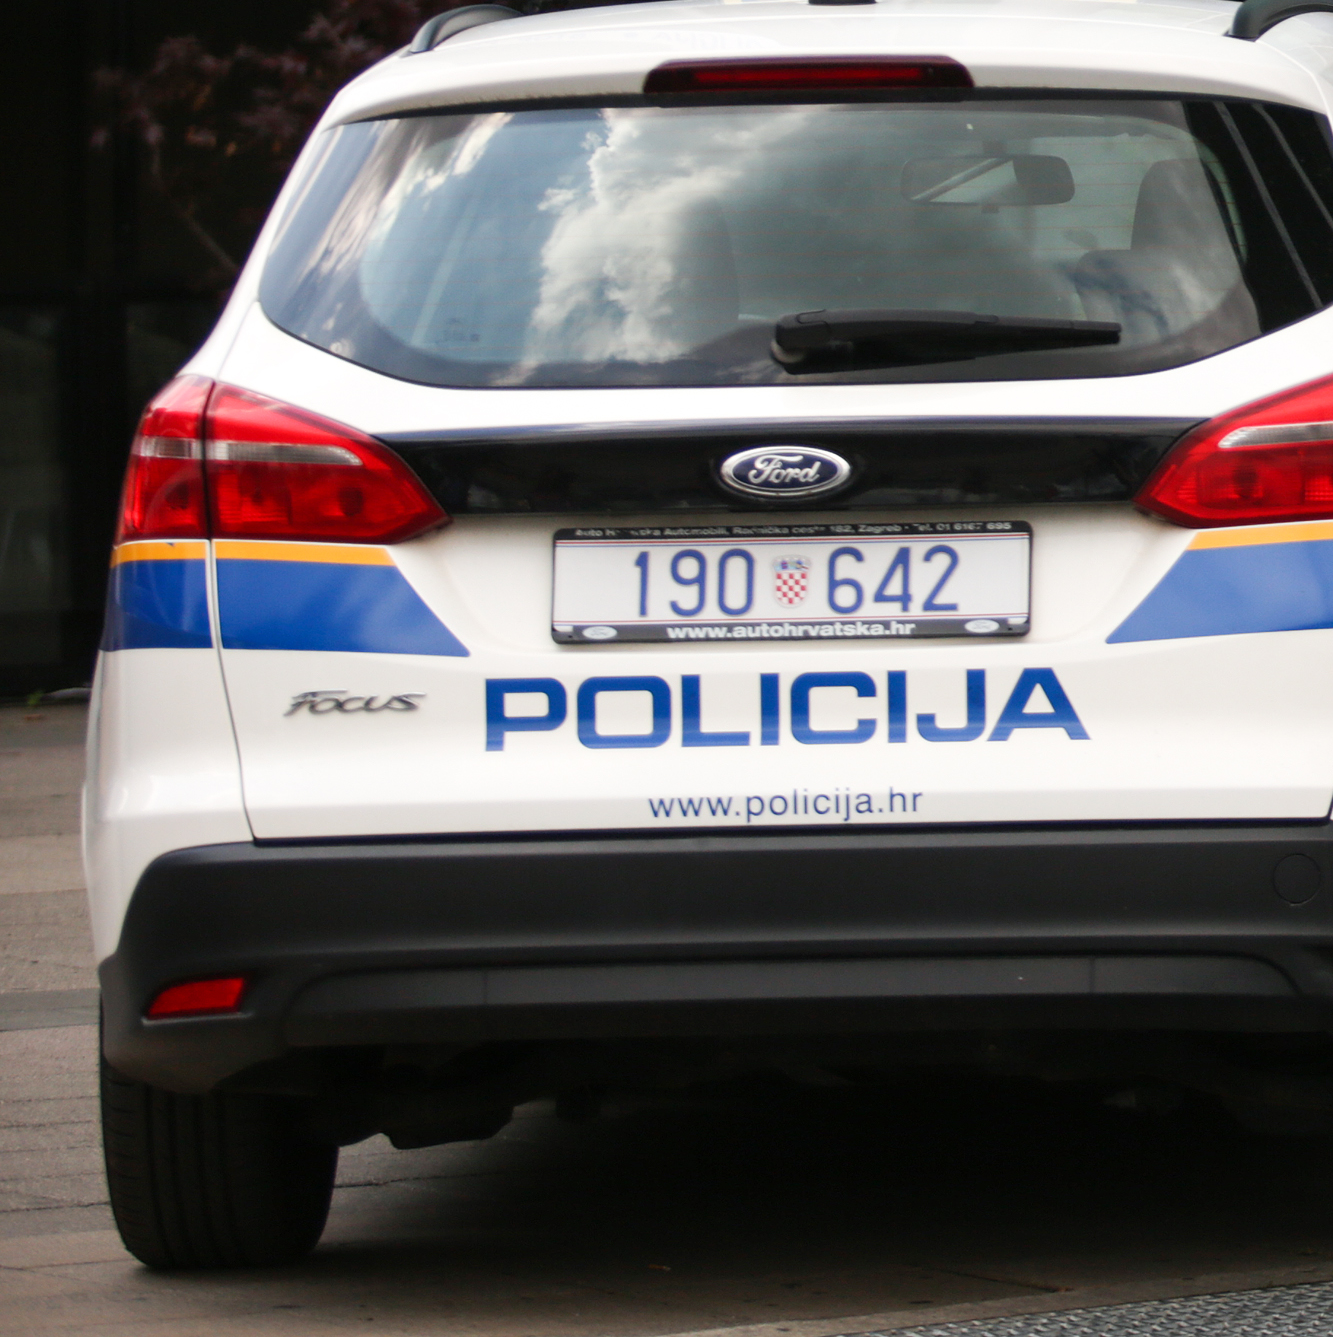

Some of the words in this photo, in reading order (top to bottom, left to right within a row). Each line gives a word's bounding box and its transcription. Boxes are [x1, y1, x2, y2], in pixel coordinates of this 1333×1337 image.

[748, 454, 822, 484] Ford
[634, 549, 756, 617] 190
[827, 544, 960, 614] 642
[666, 621, 916, 639] www.autohrvatska.hr
[485, 667, 1090, 751] POLICIJA
[648, 786, 923, 823] www.policija.hr
